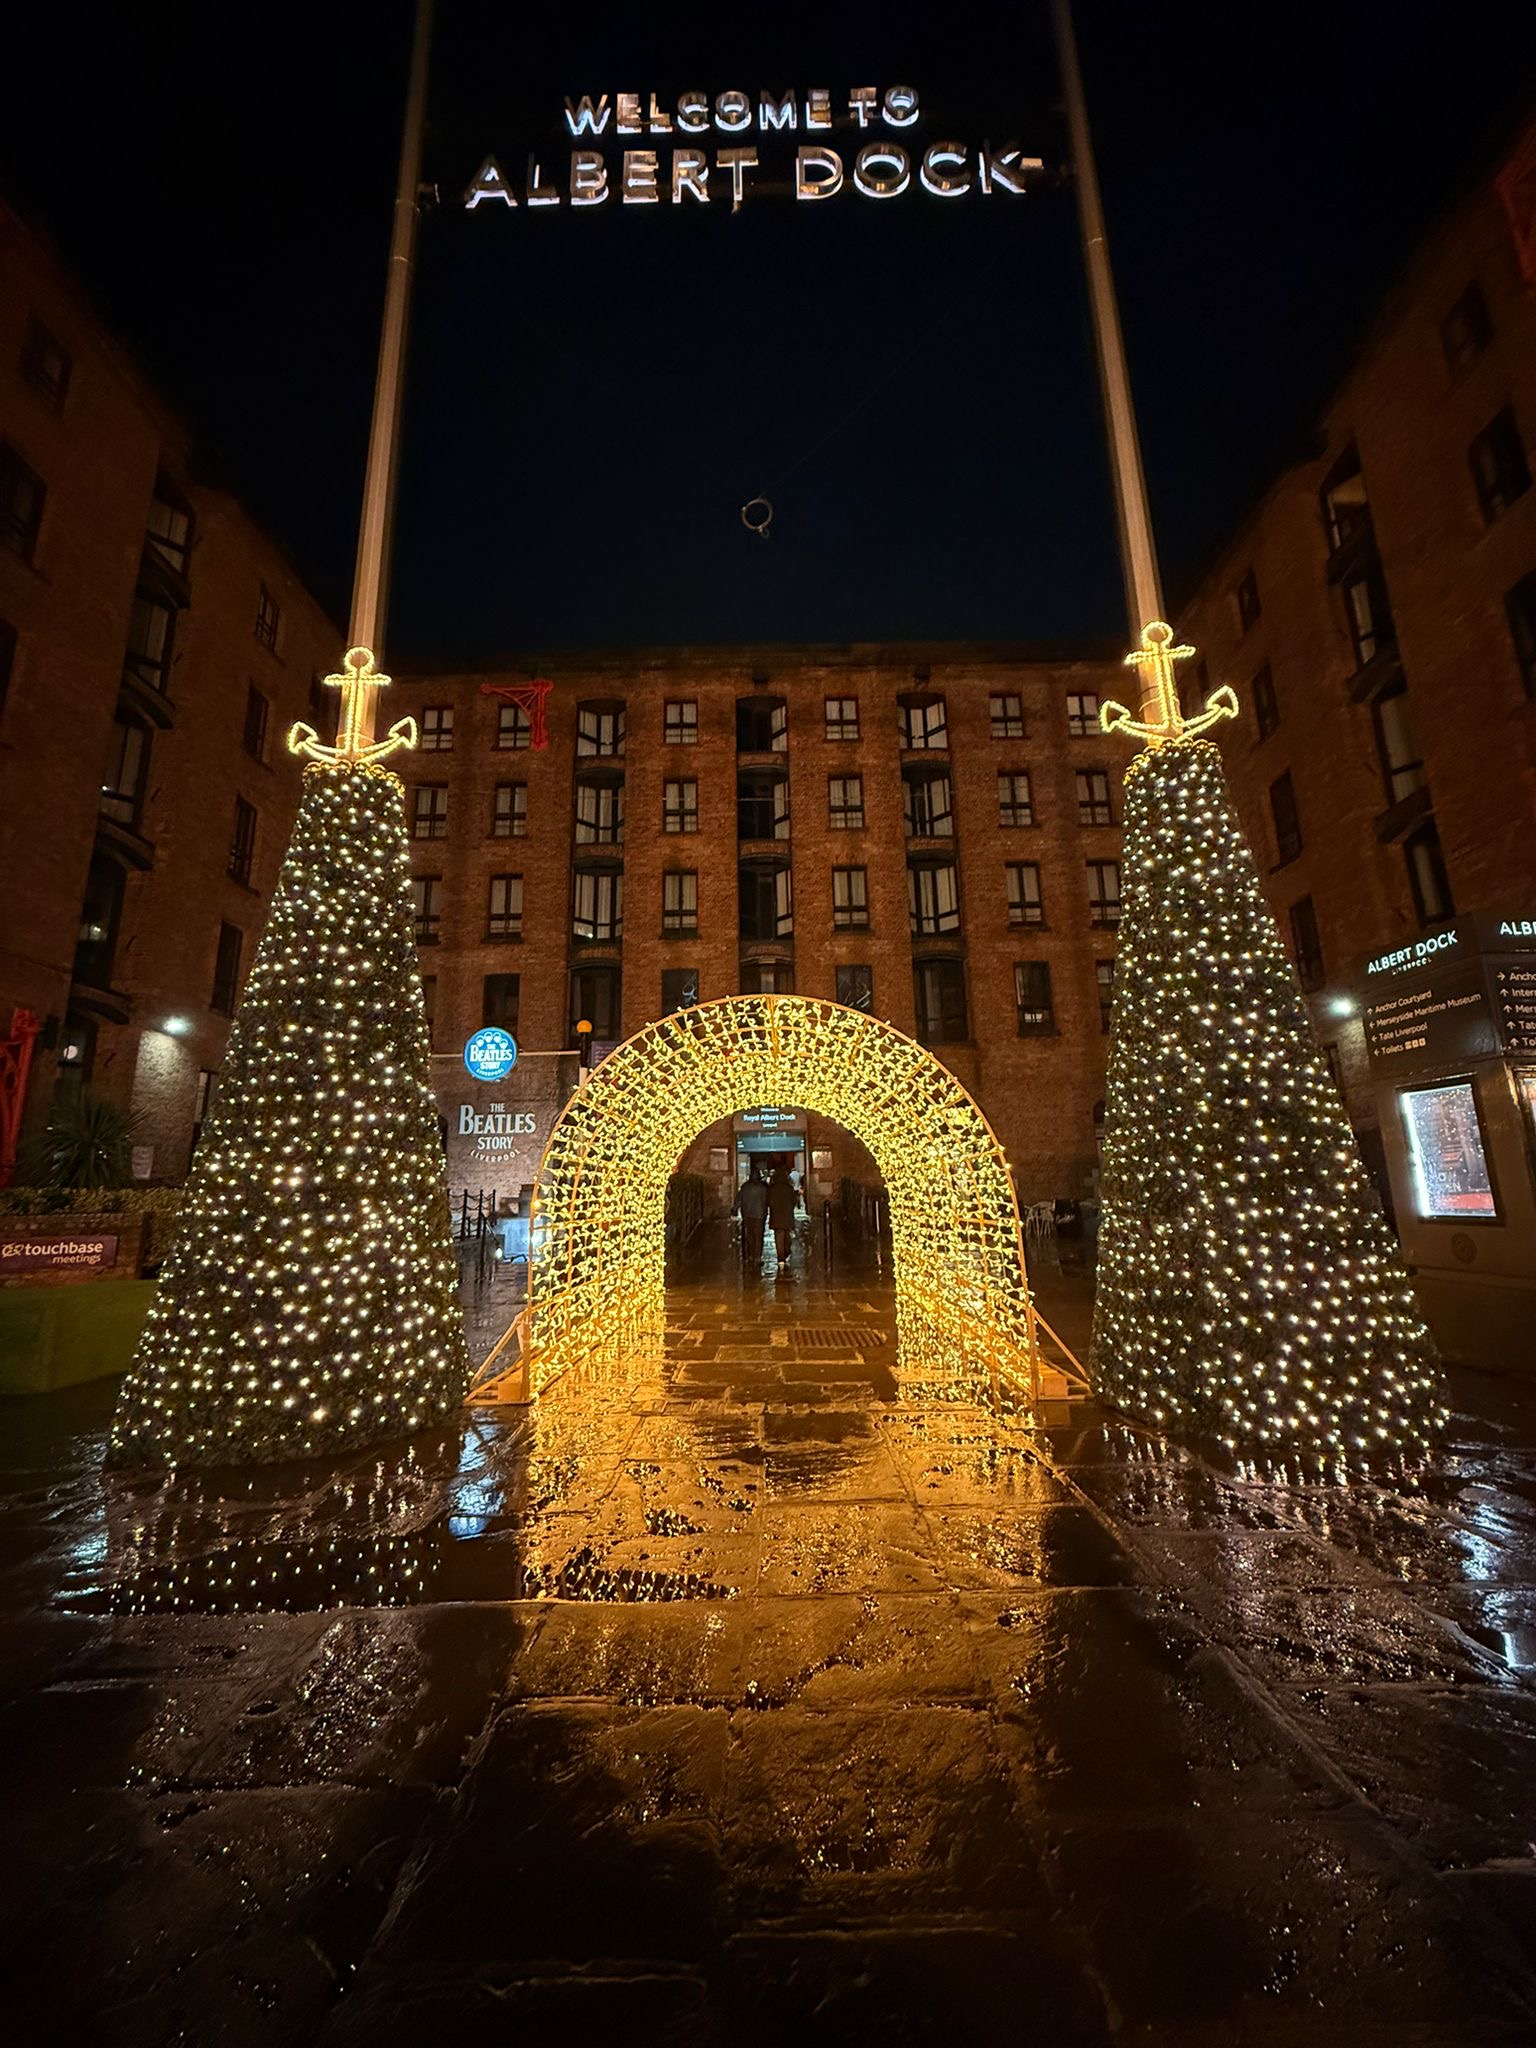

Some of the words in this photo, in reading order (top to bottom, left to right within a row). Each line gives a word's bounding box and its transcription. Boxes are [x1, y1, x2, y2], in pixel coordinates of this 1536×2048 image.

[564, 89, 832, 135] WELCOME
[849, 86, 919, 127] TO
[465, 149, 758, 208] ALBERT
[796, 141, 1027, 199] DOCK
[1368, 947, 1412, 974] ALBERT
[1416, 930, 1458, 956] DOCK
[1375, 1000, 1397, 1013] Anchor
[1398, 990, 1432, 1007] Courtyard
[1515, 1004, 1536, 1013] Mer
[1376, 1011, 1414, 1027] Merseyside
[1415, 1002, 1447, 1017] Maritime
[1447, 993, 1482, 1008] Museum
[1379, 1031, 1395, 1041] Tate
[1395, 1022, 1428, 1038] Liverpool
[470, 1044, 512, 1062] BEATLES
[1381, 1044, 1404, 1055] Toilets
[480, 1062, 500, 1070] STORY
[489, 1103, 505, 1113] THE
[459, 1104, 536, 1135] BEATLES
[477, 1136, 514, 1150] STORY
[470, 1148, 521, 1163] LIVERPOOL
[25, 1242, 103, 1256] touchbase
[52, 1254, 101, 1265] meetings
